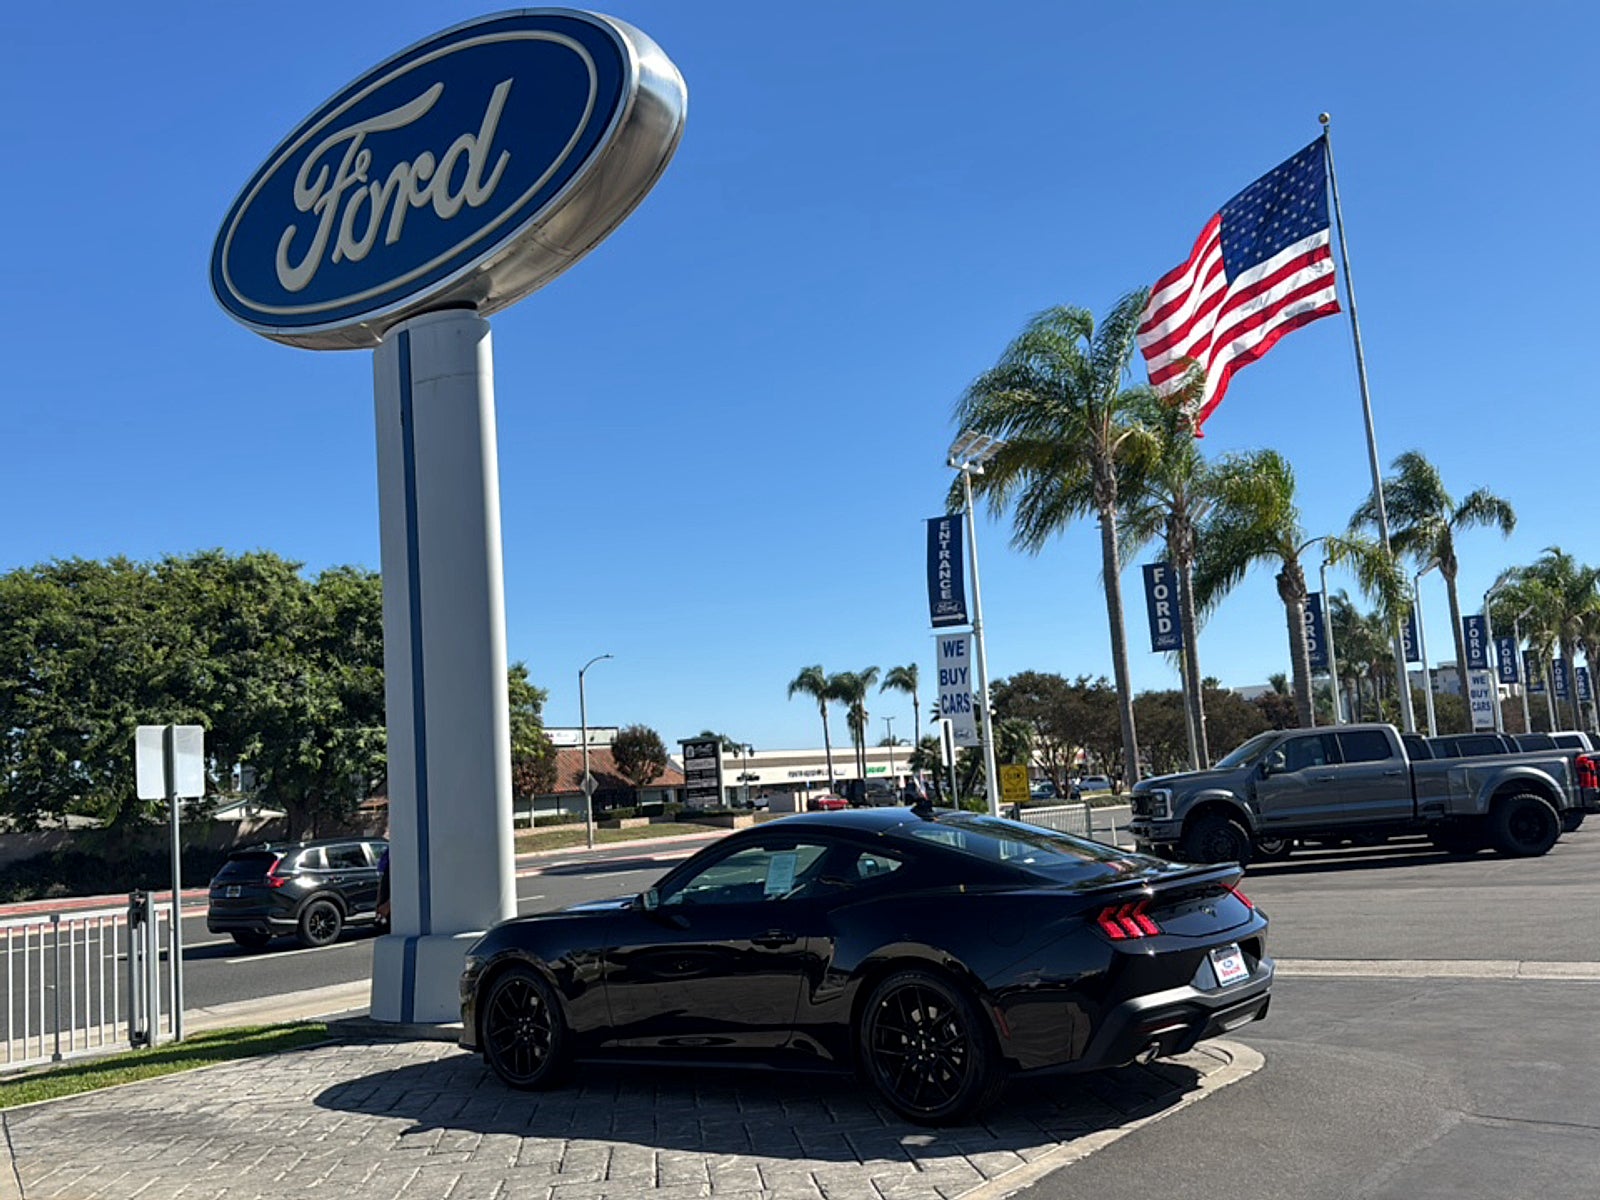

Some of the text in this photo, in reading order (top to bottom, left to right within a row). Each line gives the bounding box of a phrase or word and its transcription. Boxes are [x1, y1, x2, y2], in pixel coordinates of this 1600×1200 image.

[276, 77, 514, 292] Ford
[938, 520, 953, 600] ENTRANCE
[1153, 567, 1172, 634] FORD
[943, 639, 965, 658] WE
[1469, 618, 1481, 659] FORD
[1501, 639, 1513, 675] FORD
[940, 667, 968, 686] BUY
[1472, 676, 1486, 685] WE
[942, 692, 971, 714] CARS
[1470, 690, 1488, 699] BUY
[1472, 701, 1491, 712] CARS
